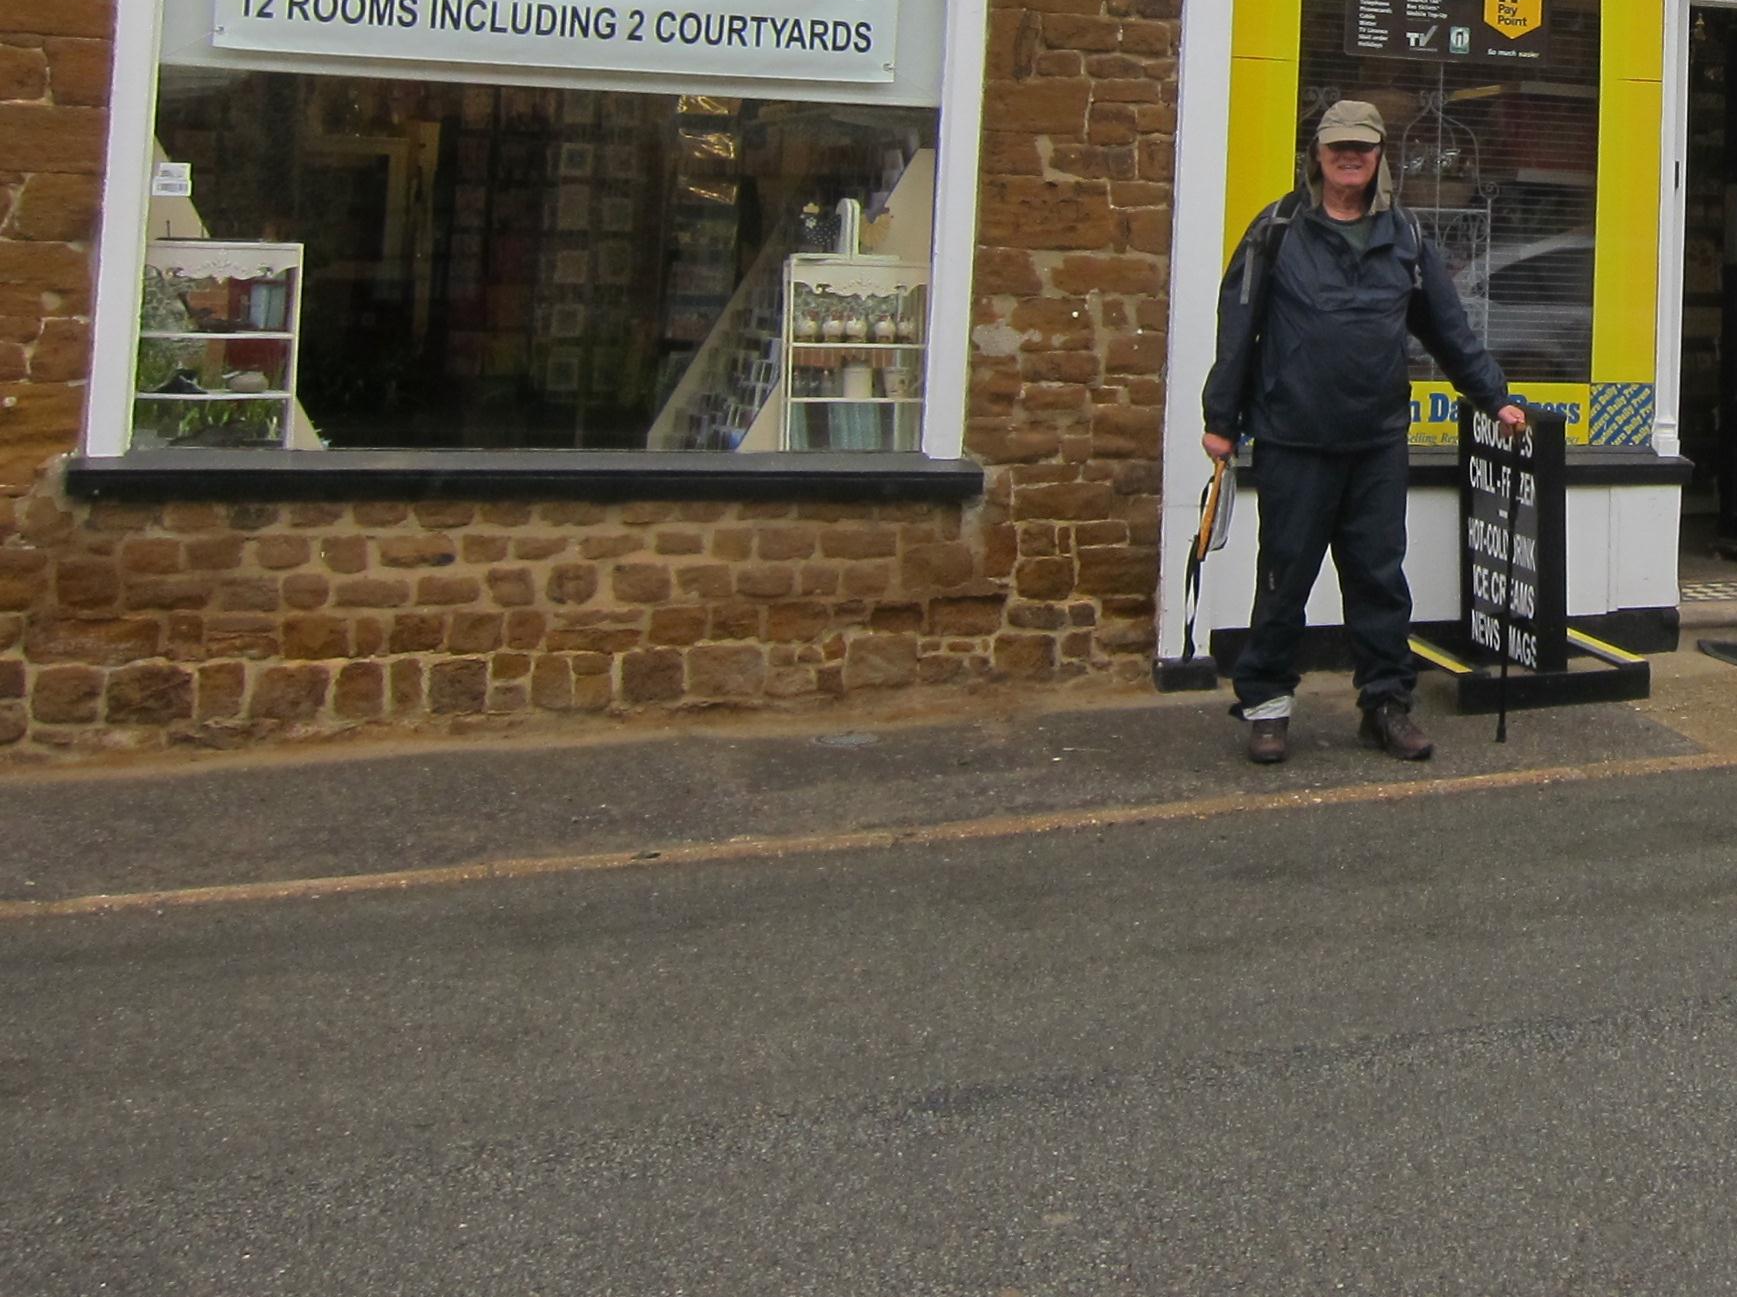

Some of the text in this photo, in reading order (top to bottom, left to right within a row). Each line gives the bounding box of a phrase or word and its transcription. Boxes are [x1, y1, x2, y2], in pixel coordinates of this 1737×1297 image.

[1498, 4, 1517, 17] Pay
[1498, 15, 1527, 26] Point
[627, 9, 645, 41] 2
[655, 11, 872, 53] COURTYARDS
[1472, 564, 1489, 600] ICE
[1471, 609, 1537, 669] NEWS MAGS
